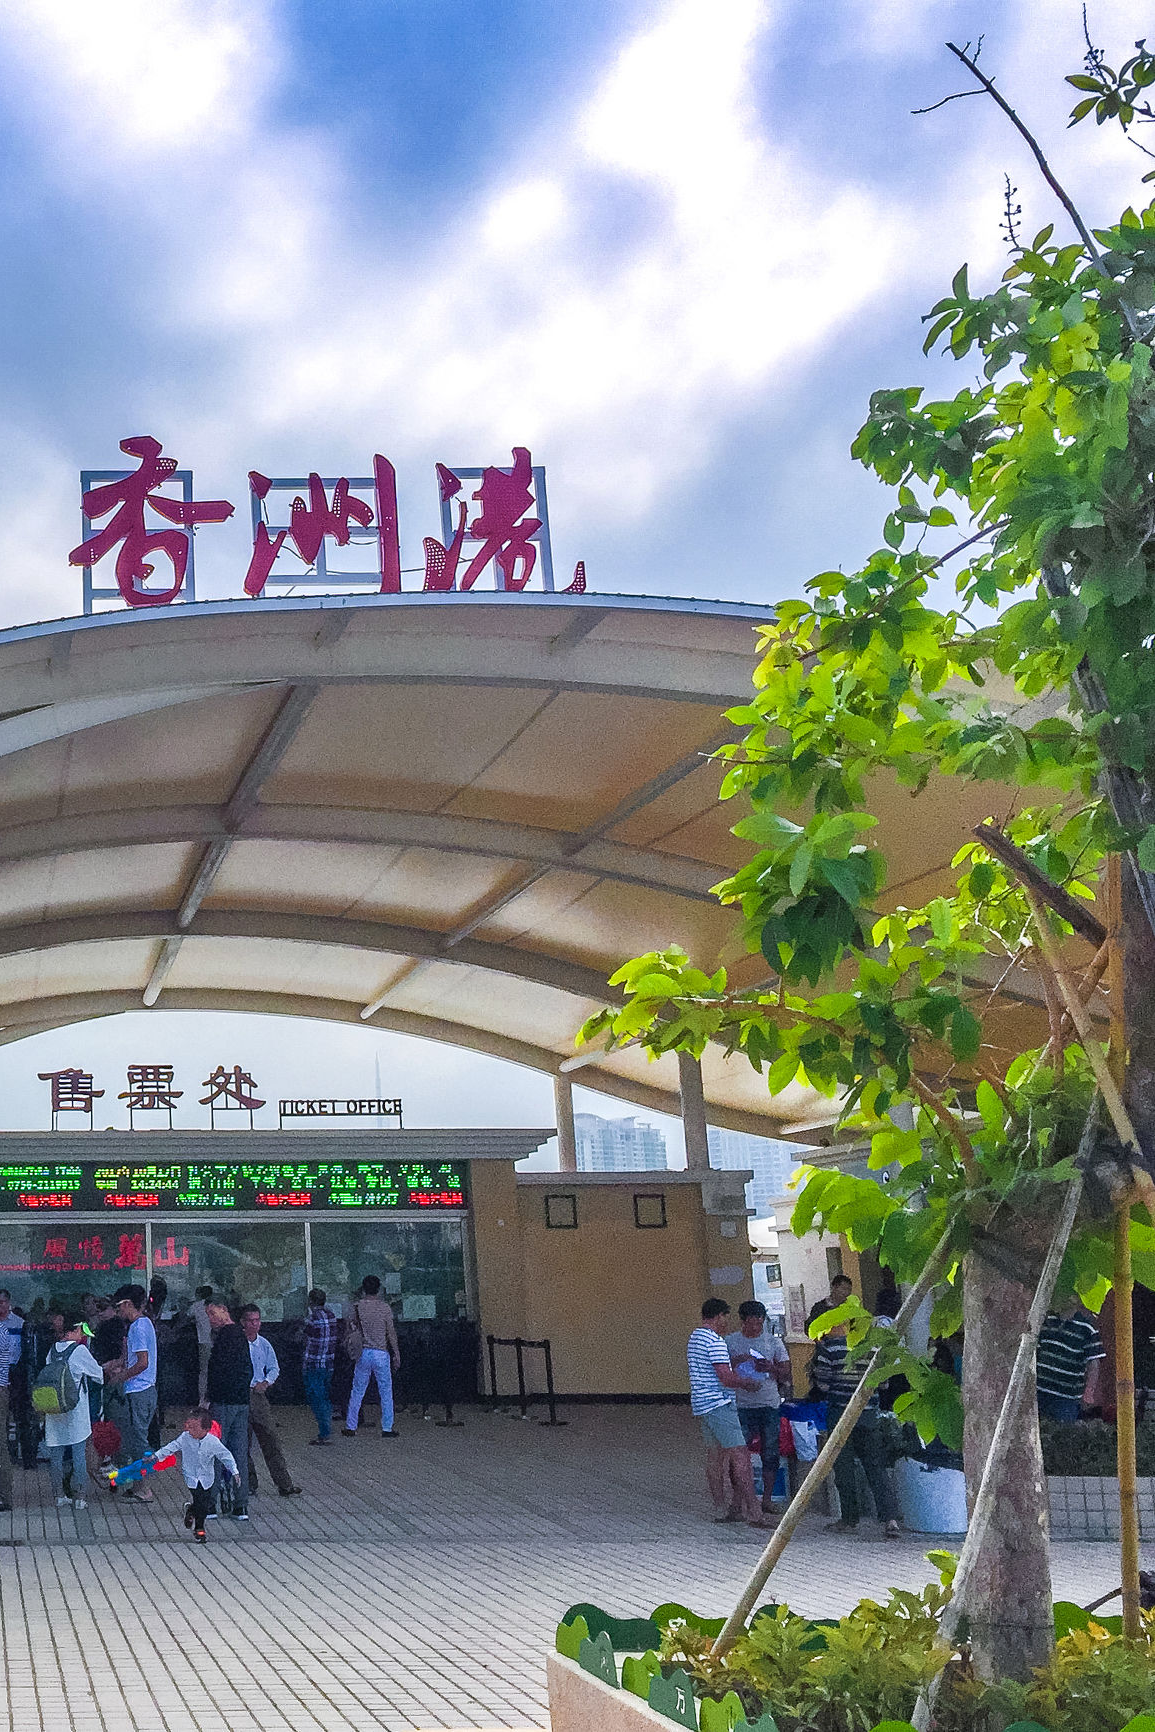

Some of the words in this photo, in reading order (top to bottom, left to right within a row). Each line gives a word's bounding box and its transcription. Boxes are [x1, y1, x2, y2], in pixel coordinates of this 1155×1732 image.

[69, 436, 586, 607] 香洲港
[37, 1064, 266, 1113] 售票处
[279, 1099, 338, 1116] TICKET
[347, 1098, 402, 1115] OFFICE
